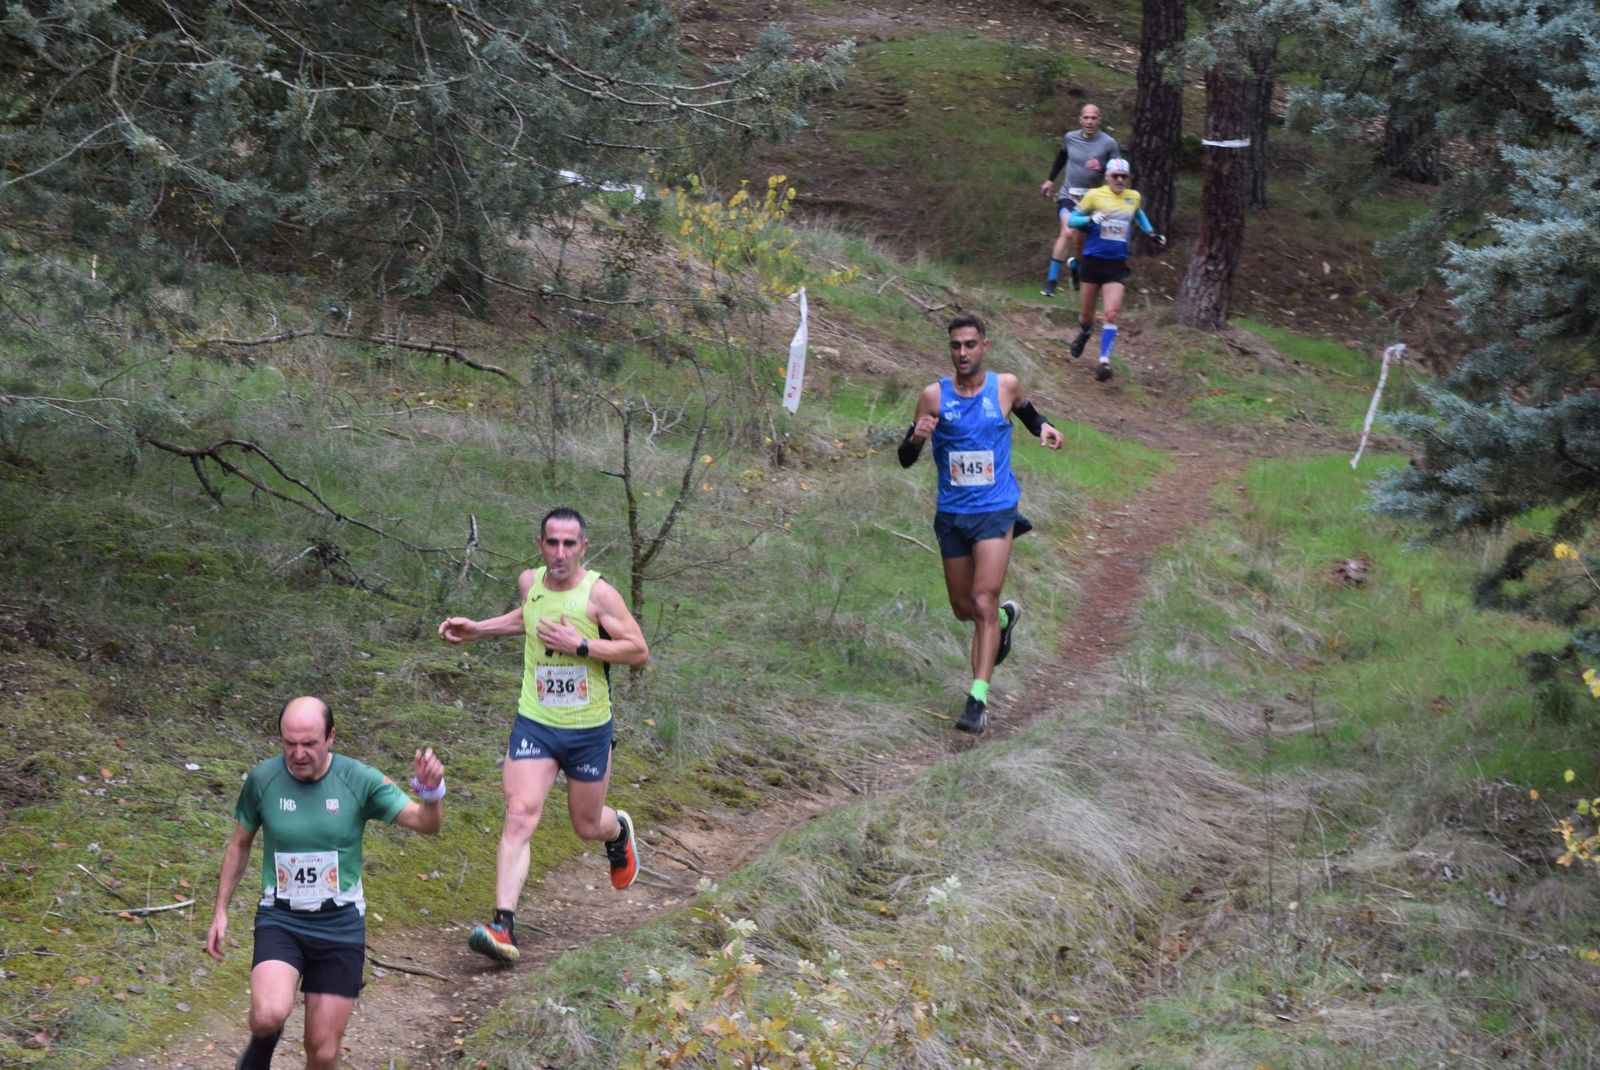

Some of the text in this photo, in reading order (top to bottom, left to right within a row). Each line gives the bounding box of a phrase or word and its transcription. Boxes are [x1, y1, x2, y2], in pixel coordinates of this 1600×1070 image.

[960, 461, 983, 474] 145
[545, 679, 575, 693] 236
[294, 866, 317, 884] 45
